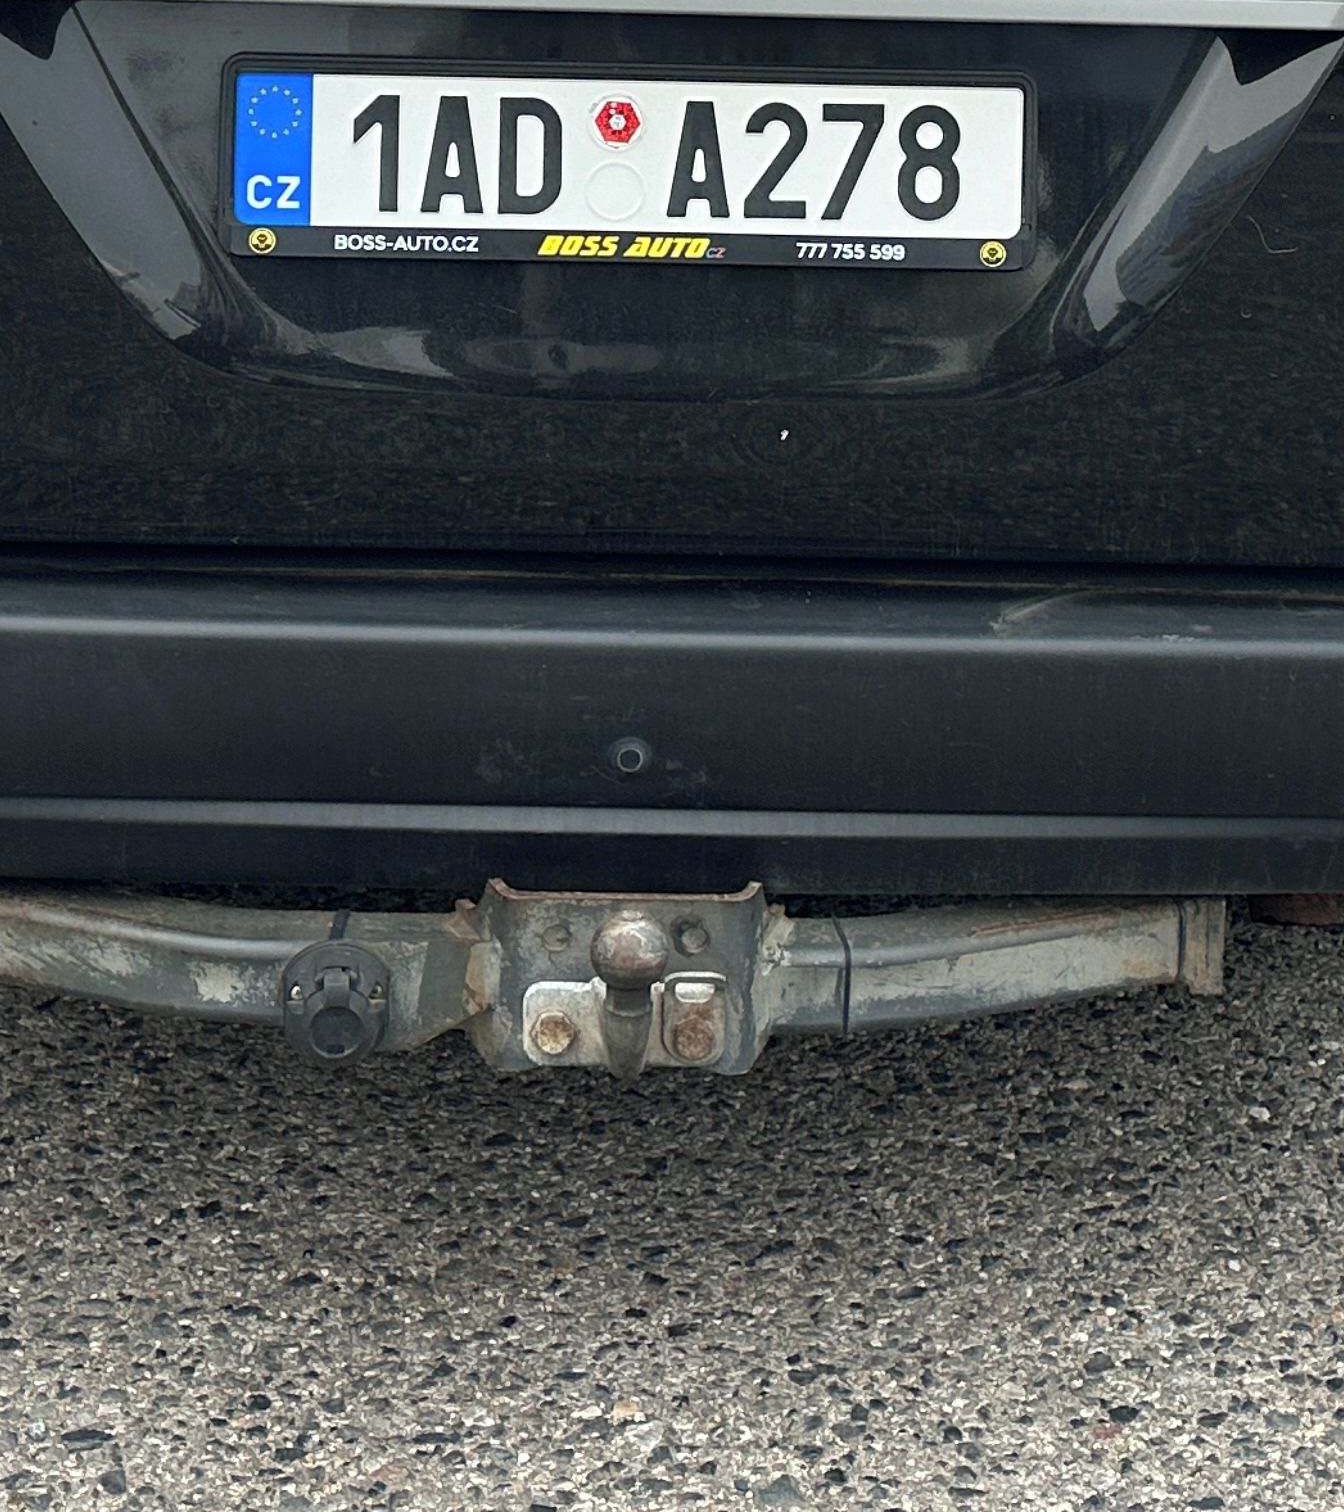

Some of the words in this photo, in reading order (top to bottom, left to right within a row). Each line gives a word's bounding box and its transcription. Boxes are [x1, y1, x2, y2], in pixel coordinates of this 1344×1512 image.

[352, 94, 563, 215] 1AD
[666, 99, 962, 221] A278
[246, 174, 301, 210] CZ
[333, 234, 479, 254] BOSS-AUTO.CZ
[537, 235, 620, 257] BOSS
[623, 236, 711, 259] AUTO
[795, 242, 827, 259] 777
[831, 243, 865, 260] 755
[869, 243, 905, 261] 599
